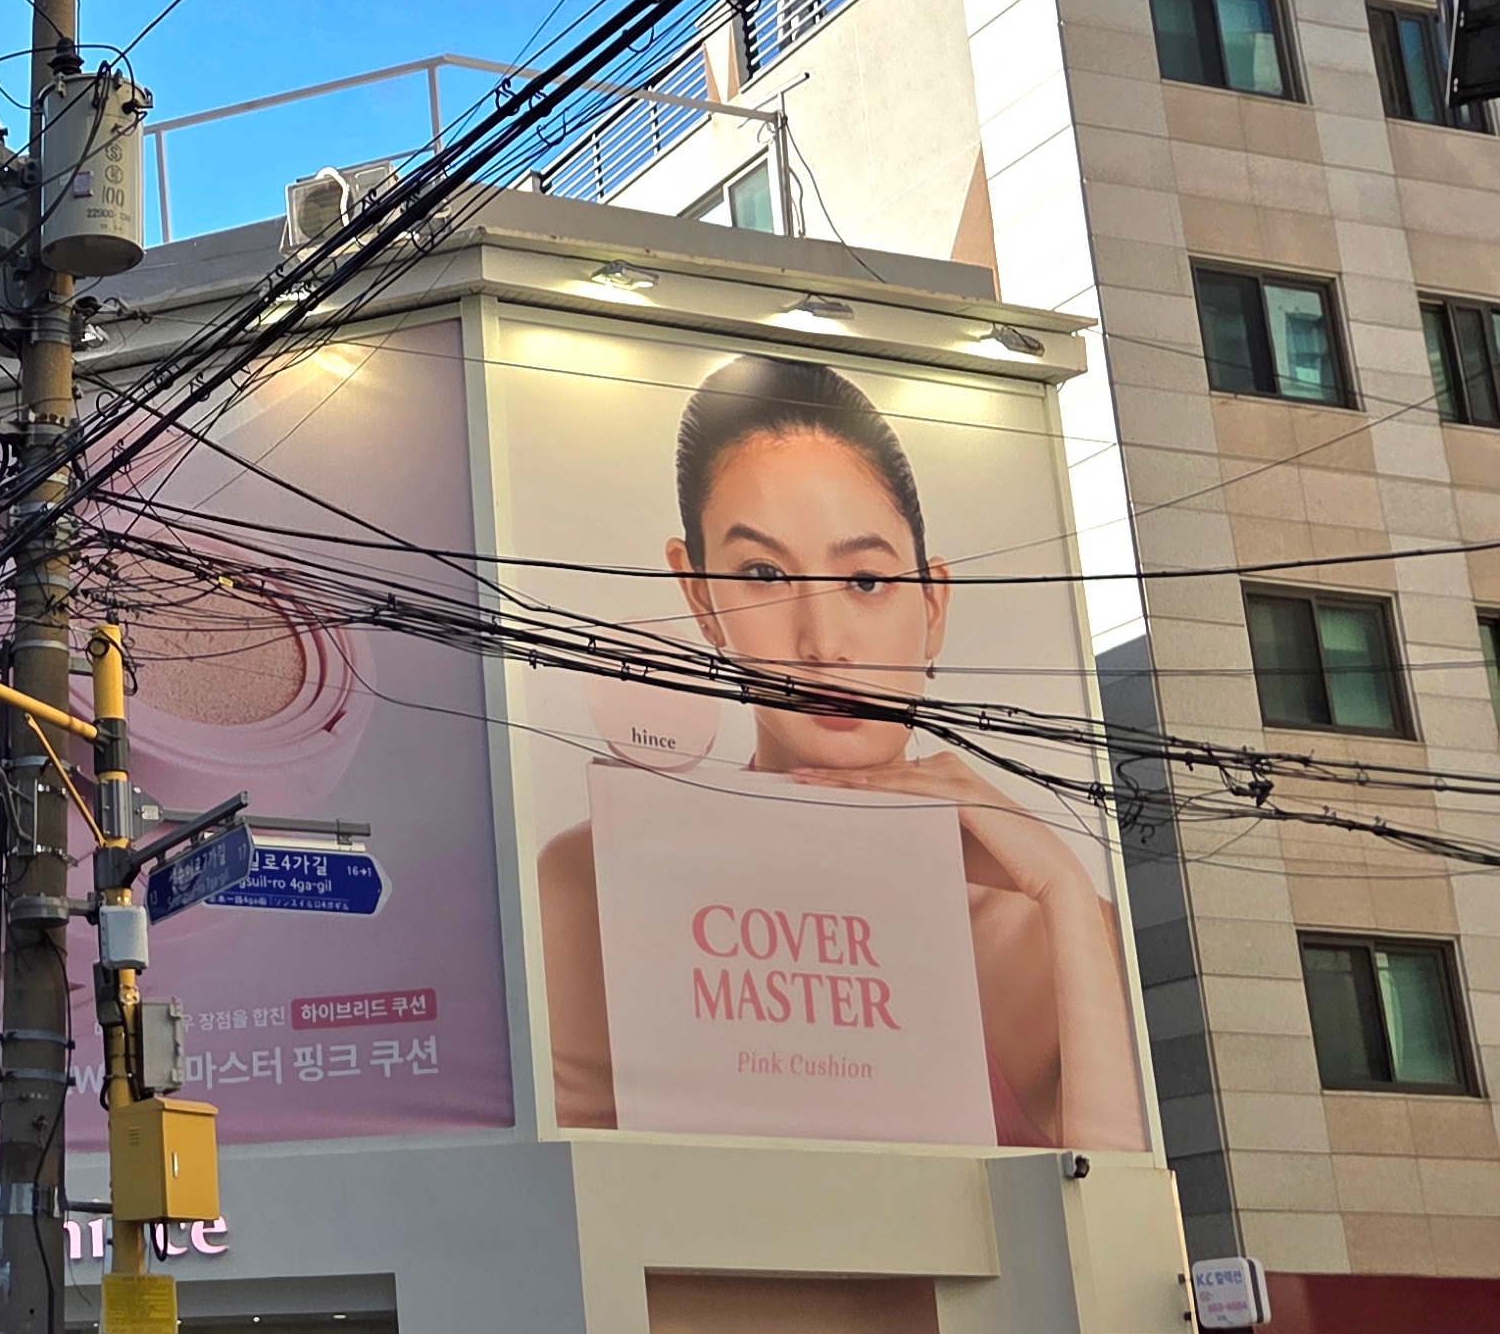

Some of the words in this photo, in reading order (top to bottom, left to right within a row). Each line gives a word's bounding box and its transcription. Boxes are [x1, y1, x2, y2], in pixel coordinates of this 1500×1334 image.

[102, 185, 125, 207] 100
[631, 726, 677, 750] hince
[290, 878, 332, 894] 4ga-gil
[691, 904, 881, 968] COVER
[199, 1010, 247, 1032] 장점을
[253, 1008, 287, 1029] 합친
[300, 999, 389, 1023] 하이브리드
[391, 994, 427, 1018] 쿠션
[693, 967, 902, 1031] MASTER
[186, 1046, 282, 1090] 마스터
[293, 1042, 362, 1083] 핑크
[369, 1034, 439, 1078] 쿠션
[737, 1050, 783, 1076] Pink
[789, 1052, 874, 1080] Cushion
